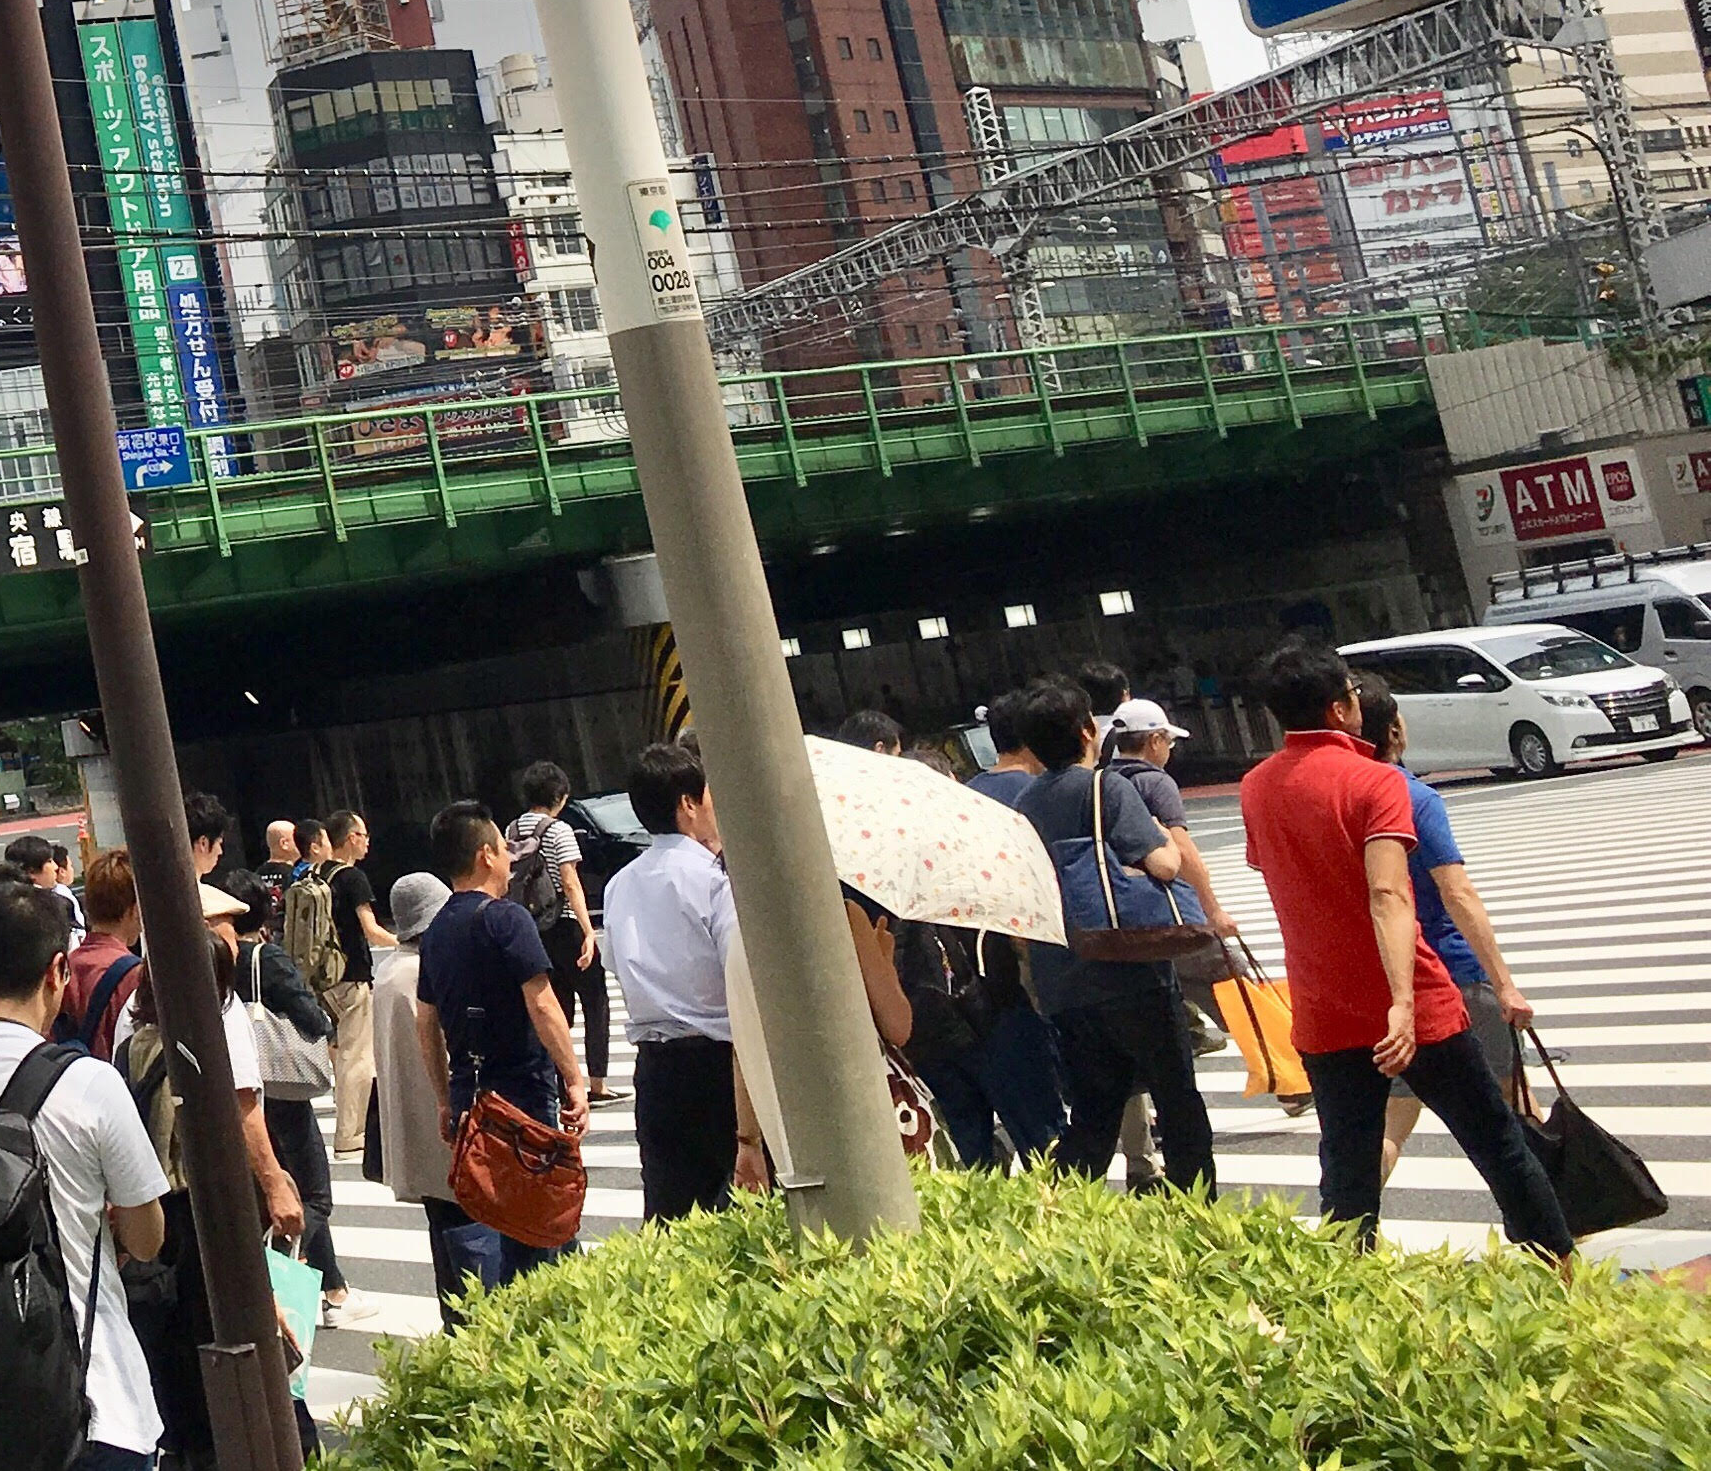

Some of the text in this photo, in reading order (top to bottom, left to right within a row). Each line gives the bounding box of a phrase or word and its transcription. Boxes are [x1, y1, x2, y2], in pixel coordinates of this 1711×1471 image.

[132, 54, 172, 218] Beauty station
[1345, 155, 1458, 187] ヨドバシ
[1382, 180, 1464, 216] カメラ
[648, 255, 675, 270] 004
[652, 269, 691, 293] 0028
[1515, 469, 1592, 514] ATM
[1605, 472, 1630, 485] EPOS
